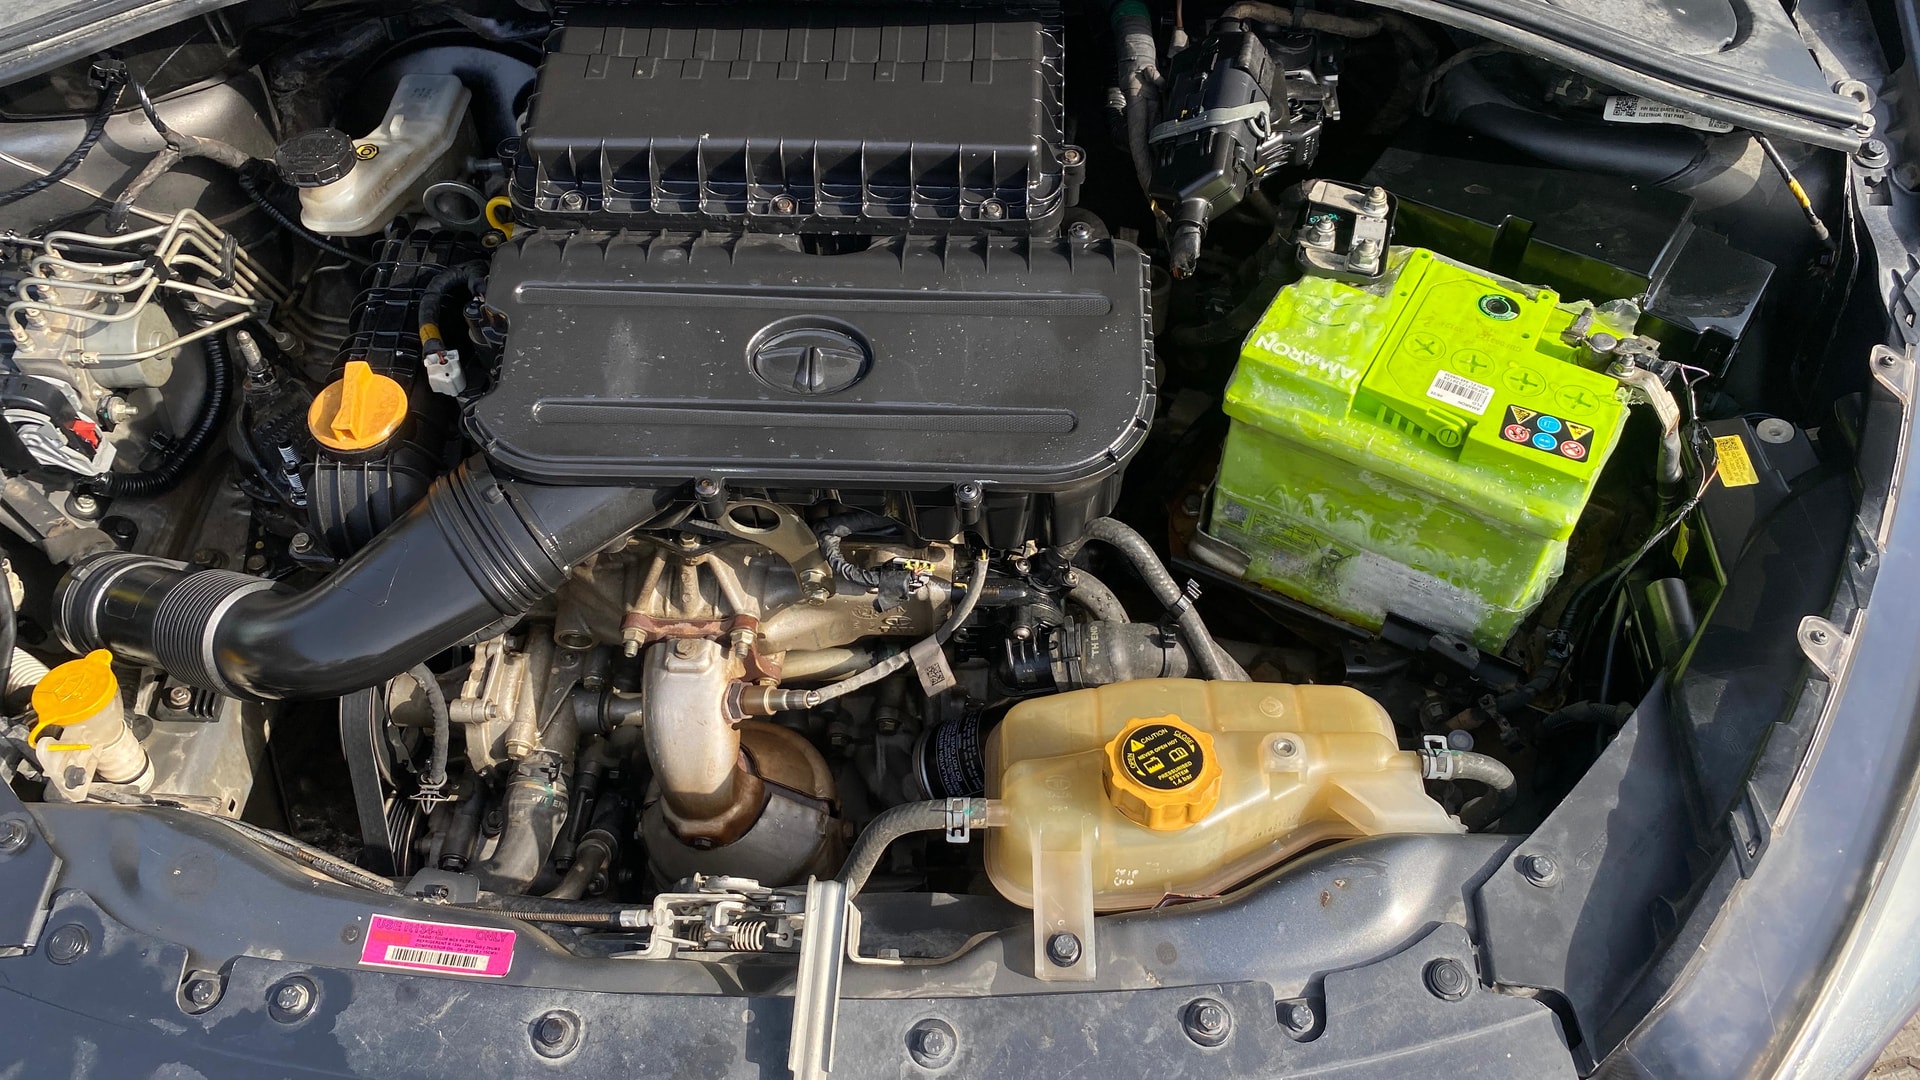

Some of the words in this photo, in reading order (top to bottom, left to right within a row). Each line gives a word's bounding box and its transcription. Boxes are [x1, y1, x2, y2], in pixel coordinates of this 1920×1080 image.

[1254, 335, 1358, 379] AMARON
[1090, 626, 1099, 640] END
[1140, 728, 1168, 744] CAUTION
[1174, 730, 1194, 746] CLOSE
[1138, 749, 1154, 760] NEVER
[1154, 742, 1169, 754] OPEN
[1168, 738, 1178, 748] HOT
[1158, 760, 1192, 780] PRESSURISED
[1168, 769, 1189, 782] SYSTEM
[1172, 778, 1183, 786] 1.4
[1181, 774, 1192, 783] bar
[376, 918, 402, 931] USE
[475, 929, 508, 943] ONLY
